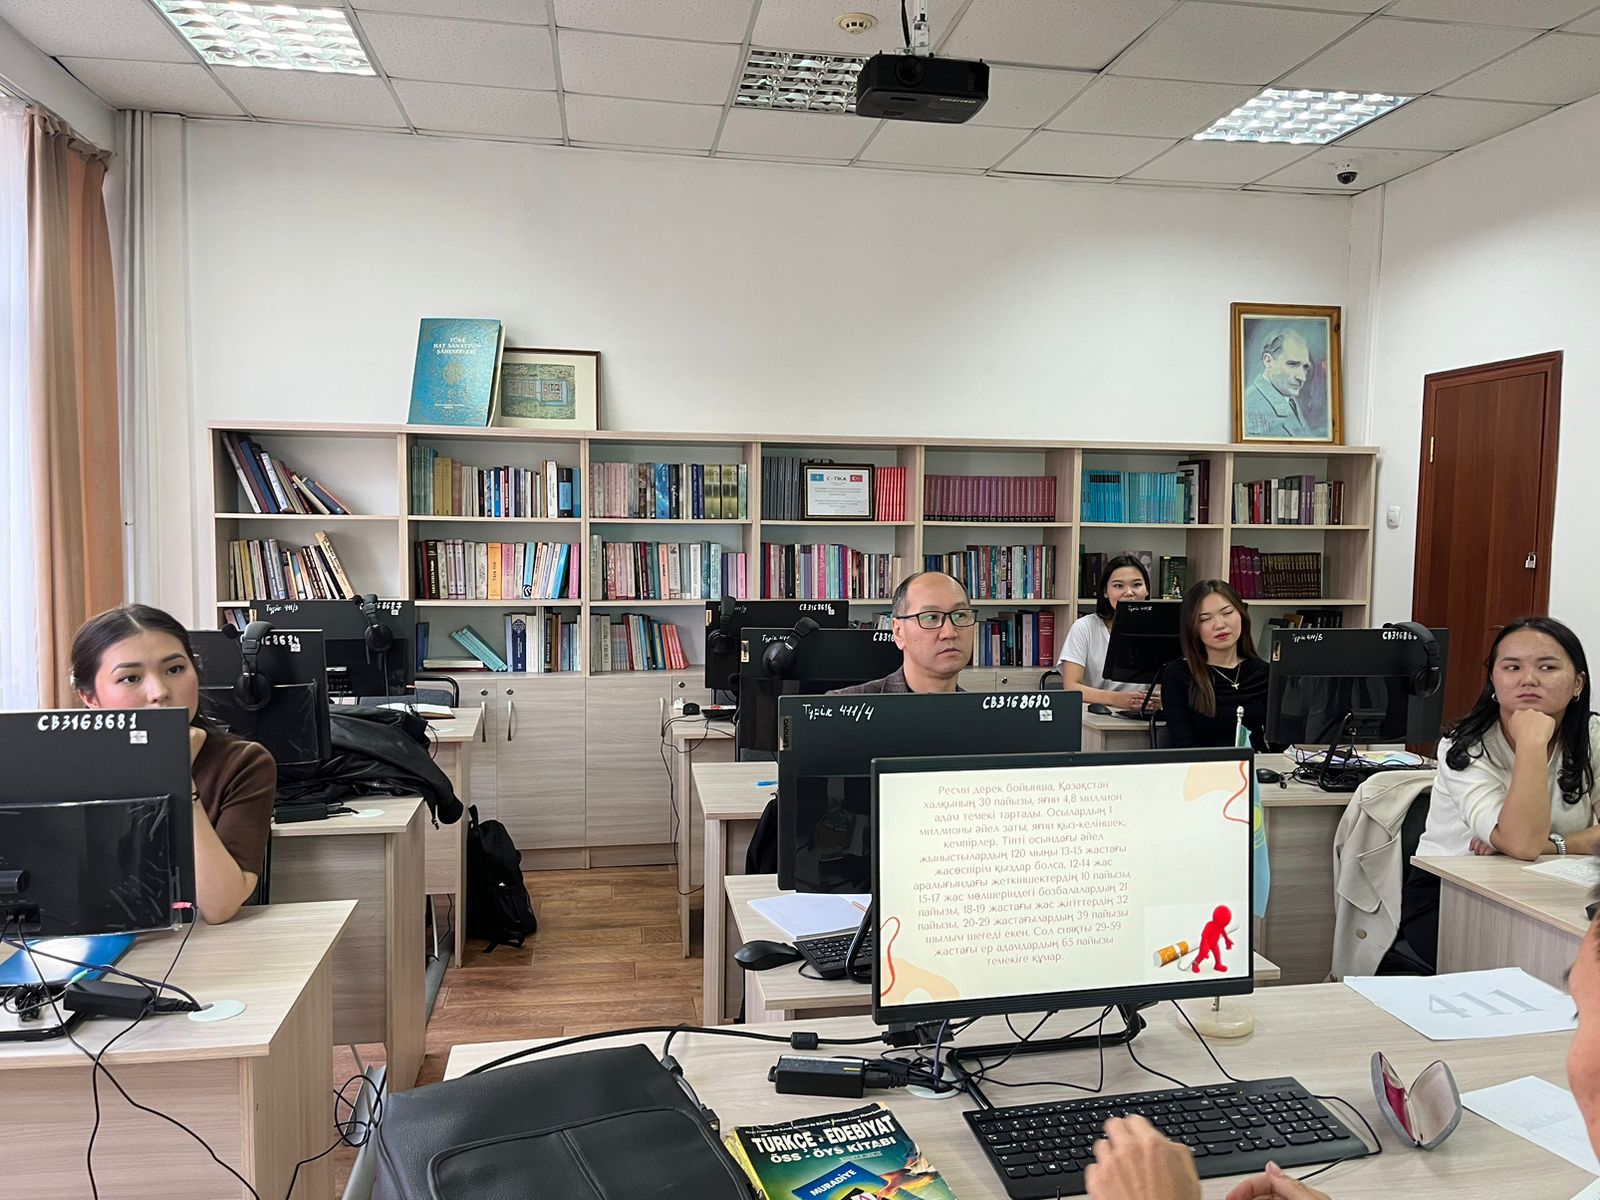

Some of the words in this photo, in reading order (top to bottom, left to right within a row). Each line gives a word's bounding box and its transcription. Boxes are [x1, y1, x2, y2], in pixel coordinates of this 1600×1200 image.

[37, 712, 138, 731] CB3168681
[839, 702, 875, 722] 411/4
[751, 1131, 818, 1152] TÜRKÇE
[827, 1115, 896, 1145] EDEBİYAT
[770, 1153, 802, 1163] ÖSS
[813, 1147, 845, 1158] ÖYS
[846, 1136, 897, 1153] KİTABI
[809, 1168, 858, 1197] MURADİYE
